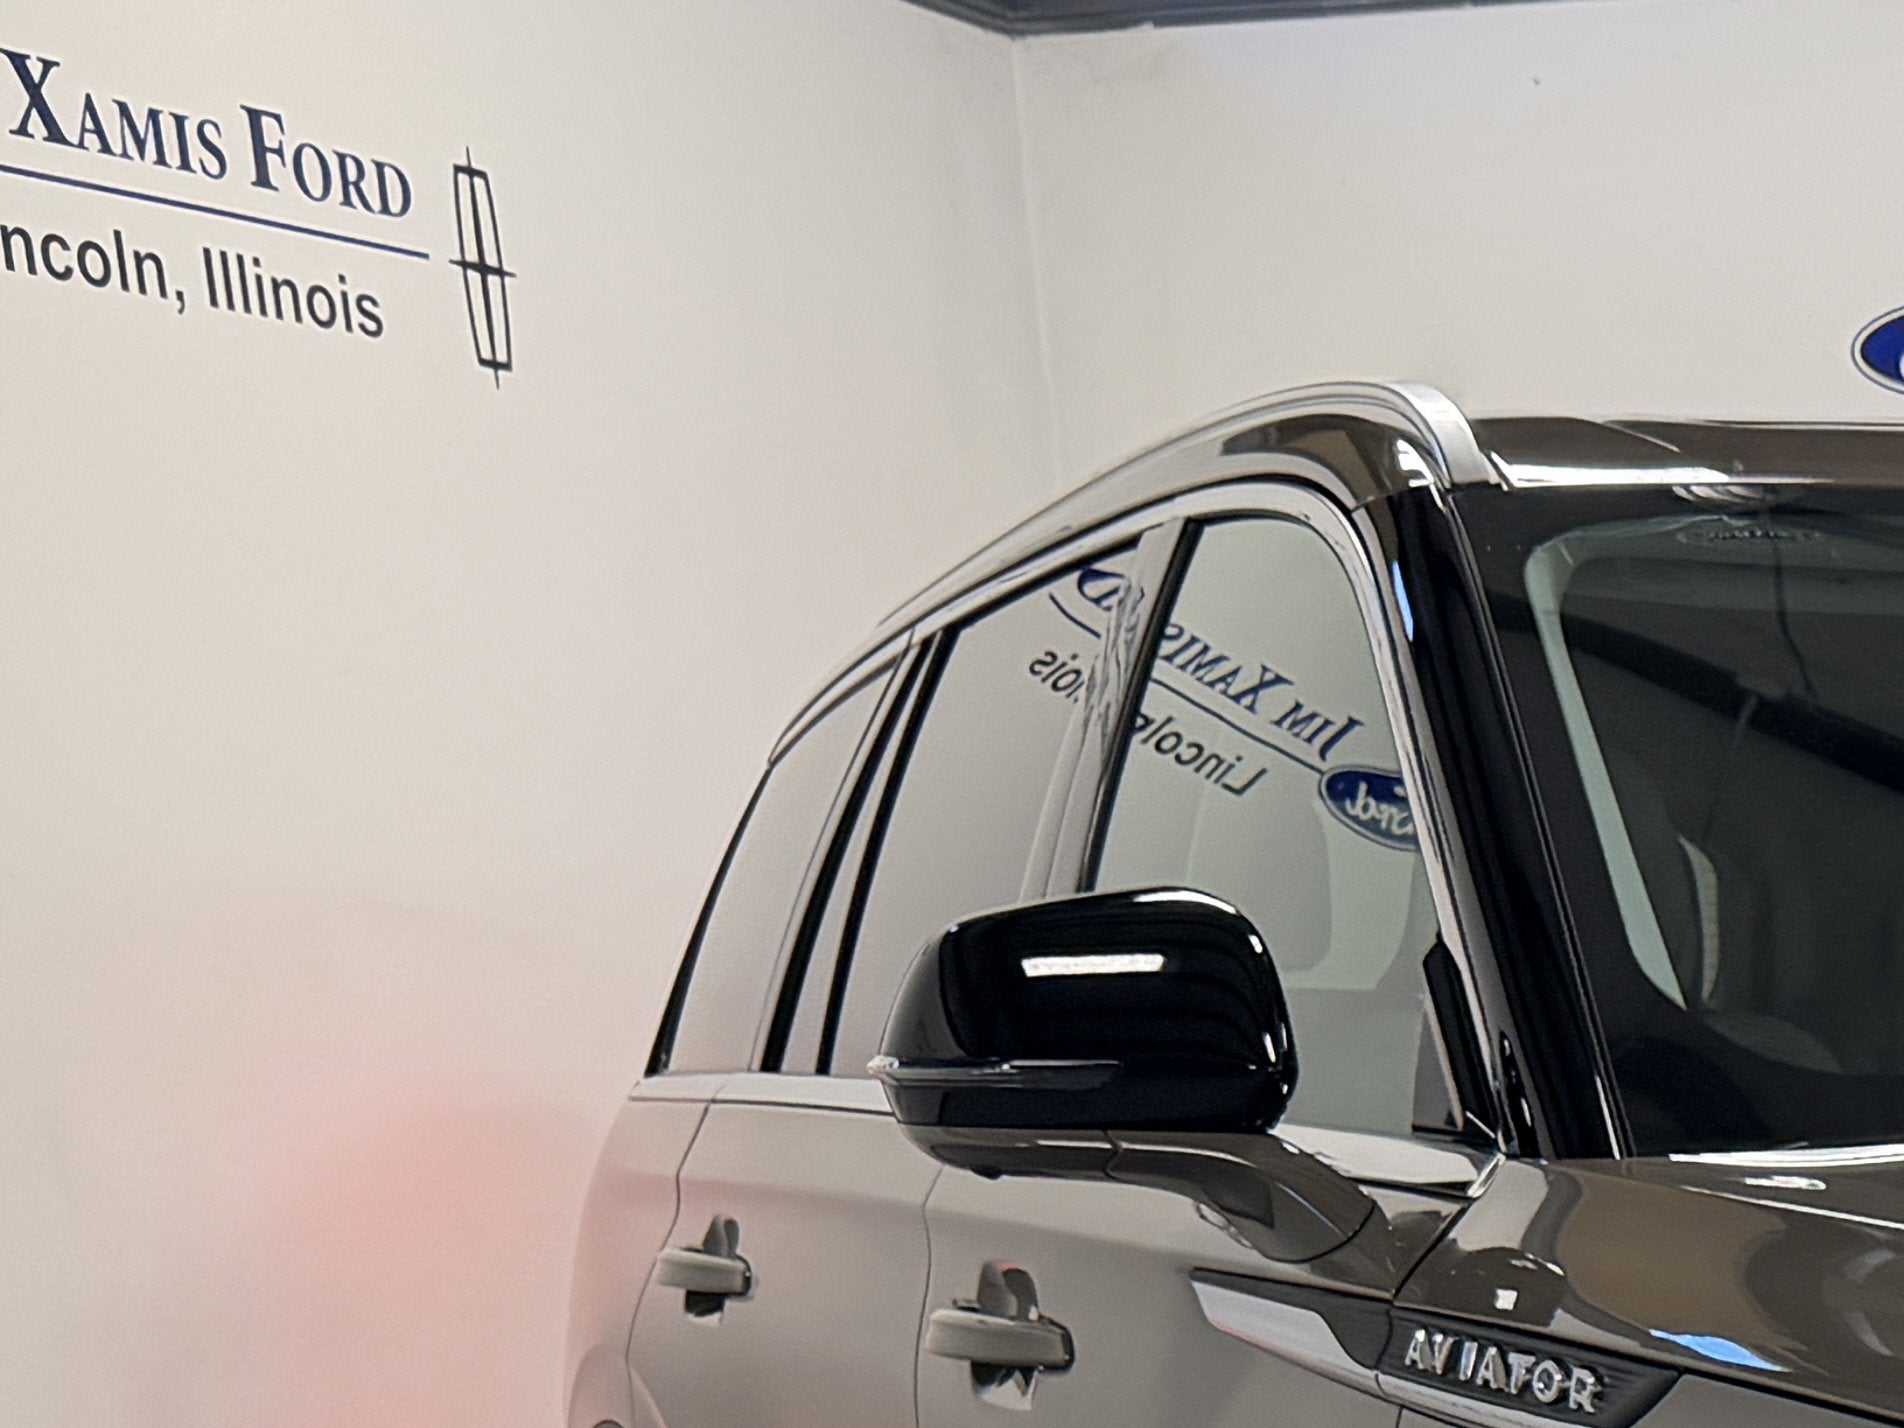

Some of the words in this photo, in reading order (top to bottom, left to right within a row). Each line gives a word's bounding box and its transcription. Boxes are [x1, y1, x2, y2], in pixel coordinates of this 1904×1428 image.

[0, 48, 228, 180] XAMIS
[240, 104, 412, 218] FORD
[0, 223, 187, 315] ncoln,
[202, 246, 385, 339] Illinois
[1404, 1328, 1603, 1414] AVIATOR
